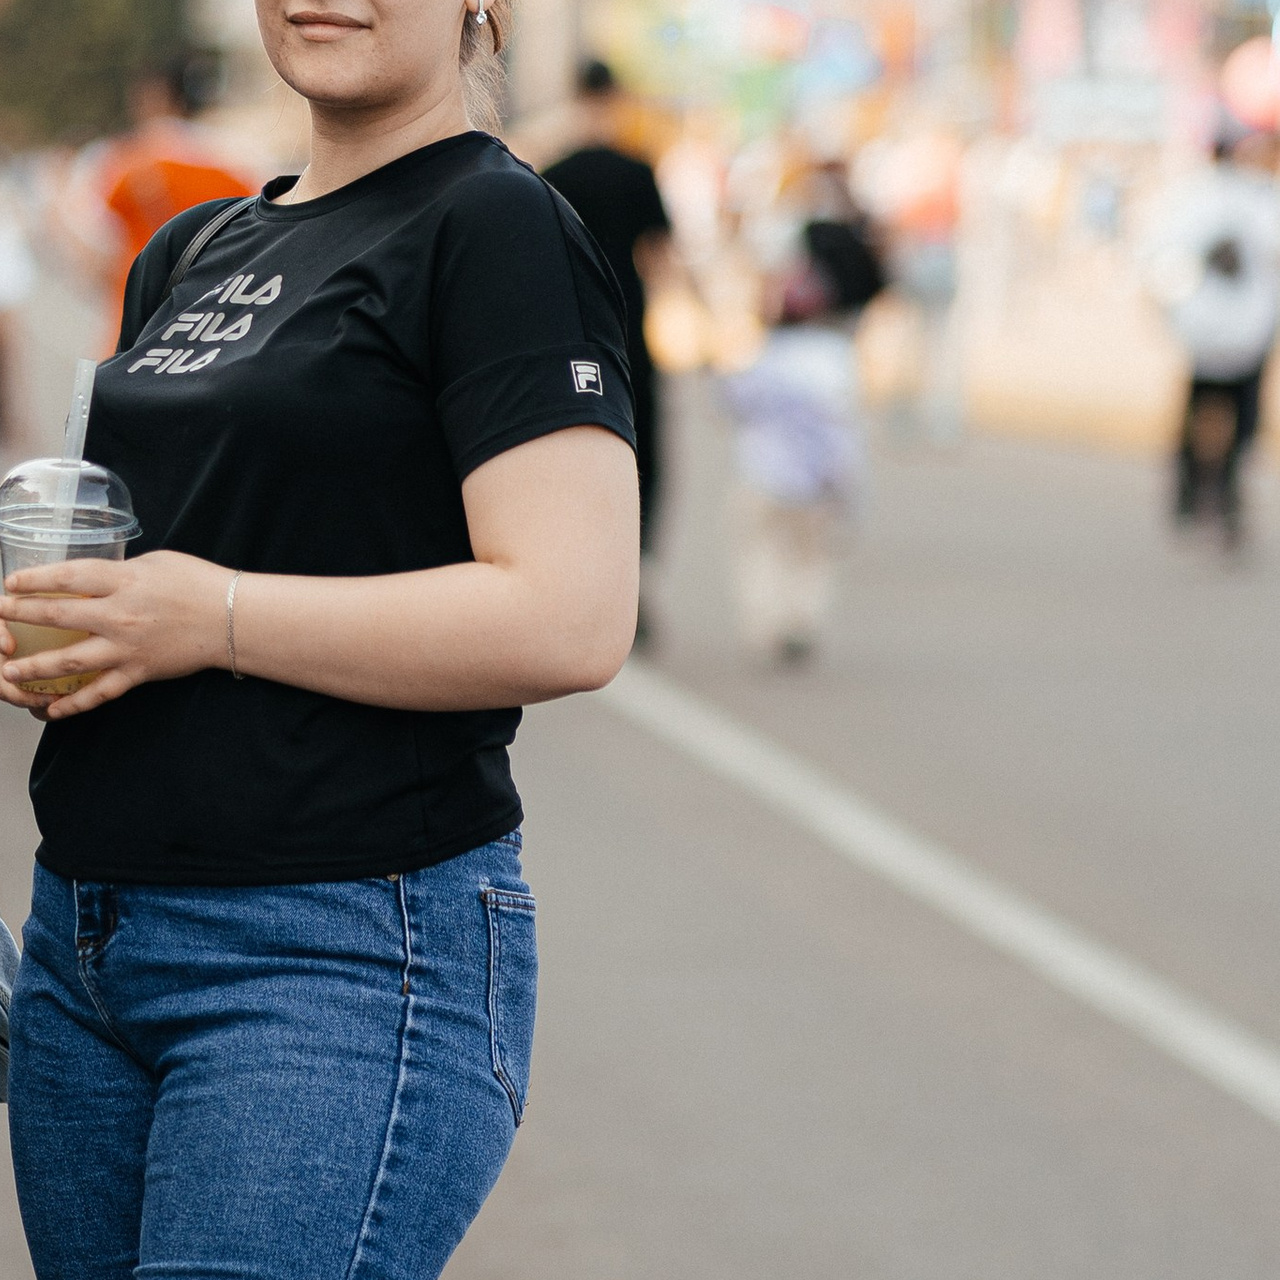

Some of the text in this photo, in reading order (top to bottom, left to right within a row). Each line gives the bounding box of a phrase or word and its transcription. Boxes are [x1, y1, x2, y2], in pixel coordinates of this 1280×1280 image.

[195, 273, 283, 305] ILA
[161, 312, 254, 342] FILA
[127, 347, 222, 374] FILA
[574, 364, 598, 390] F
